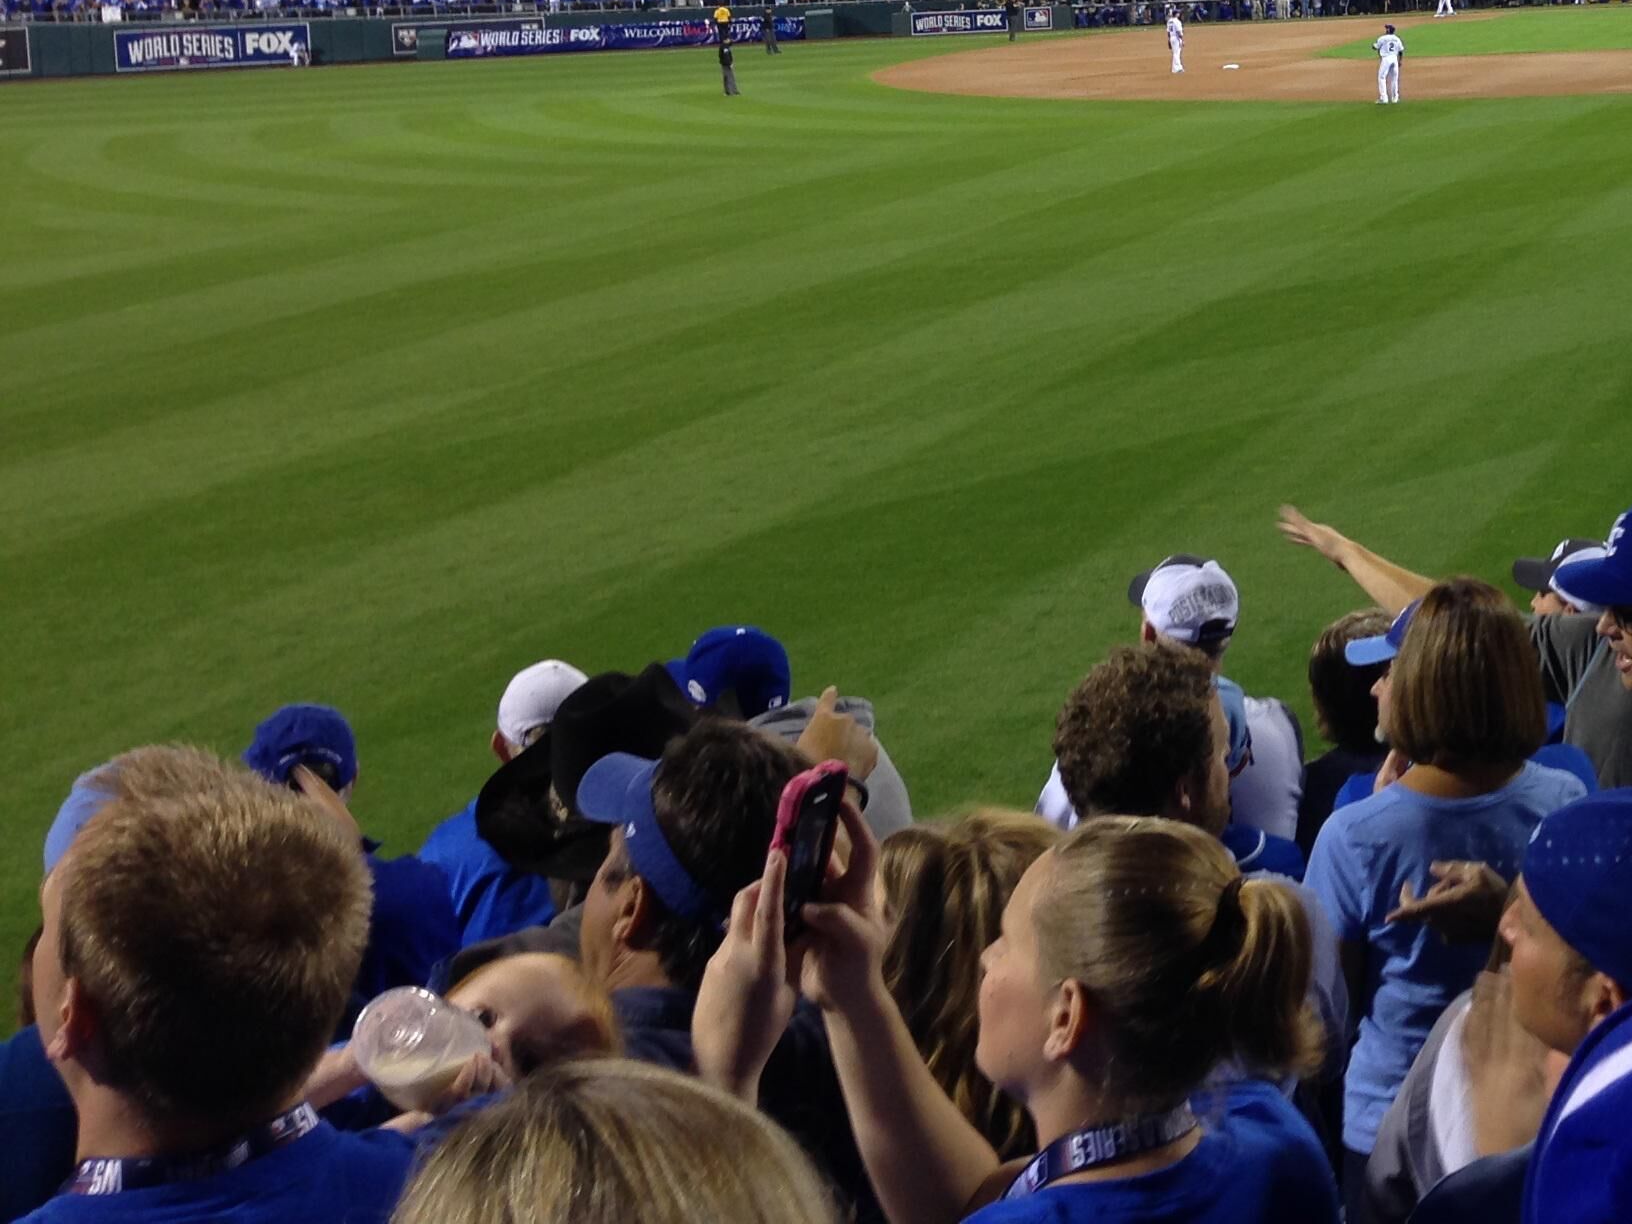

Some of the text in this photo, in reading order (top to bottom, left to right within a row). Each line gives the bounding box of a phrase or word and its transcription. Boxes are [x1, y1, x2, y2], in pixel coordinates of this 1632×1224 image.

[916, 14, 1002, 31] WORLD SERIES FOX
[481, 27, 600, 47] WORLD SERIES FOX
[128, 31, 295, 65] WORLD SERIES FOX
